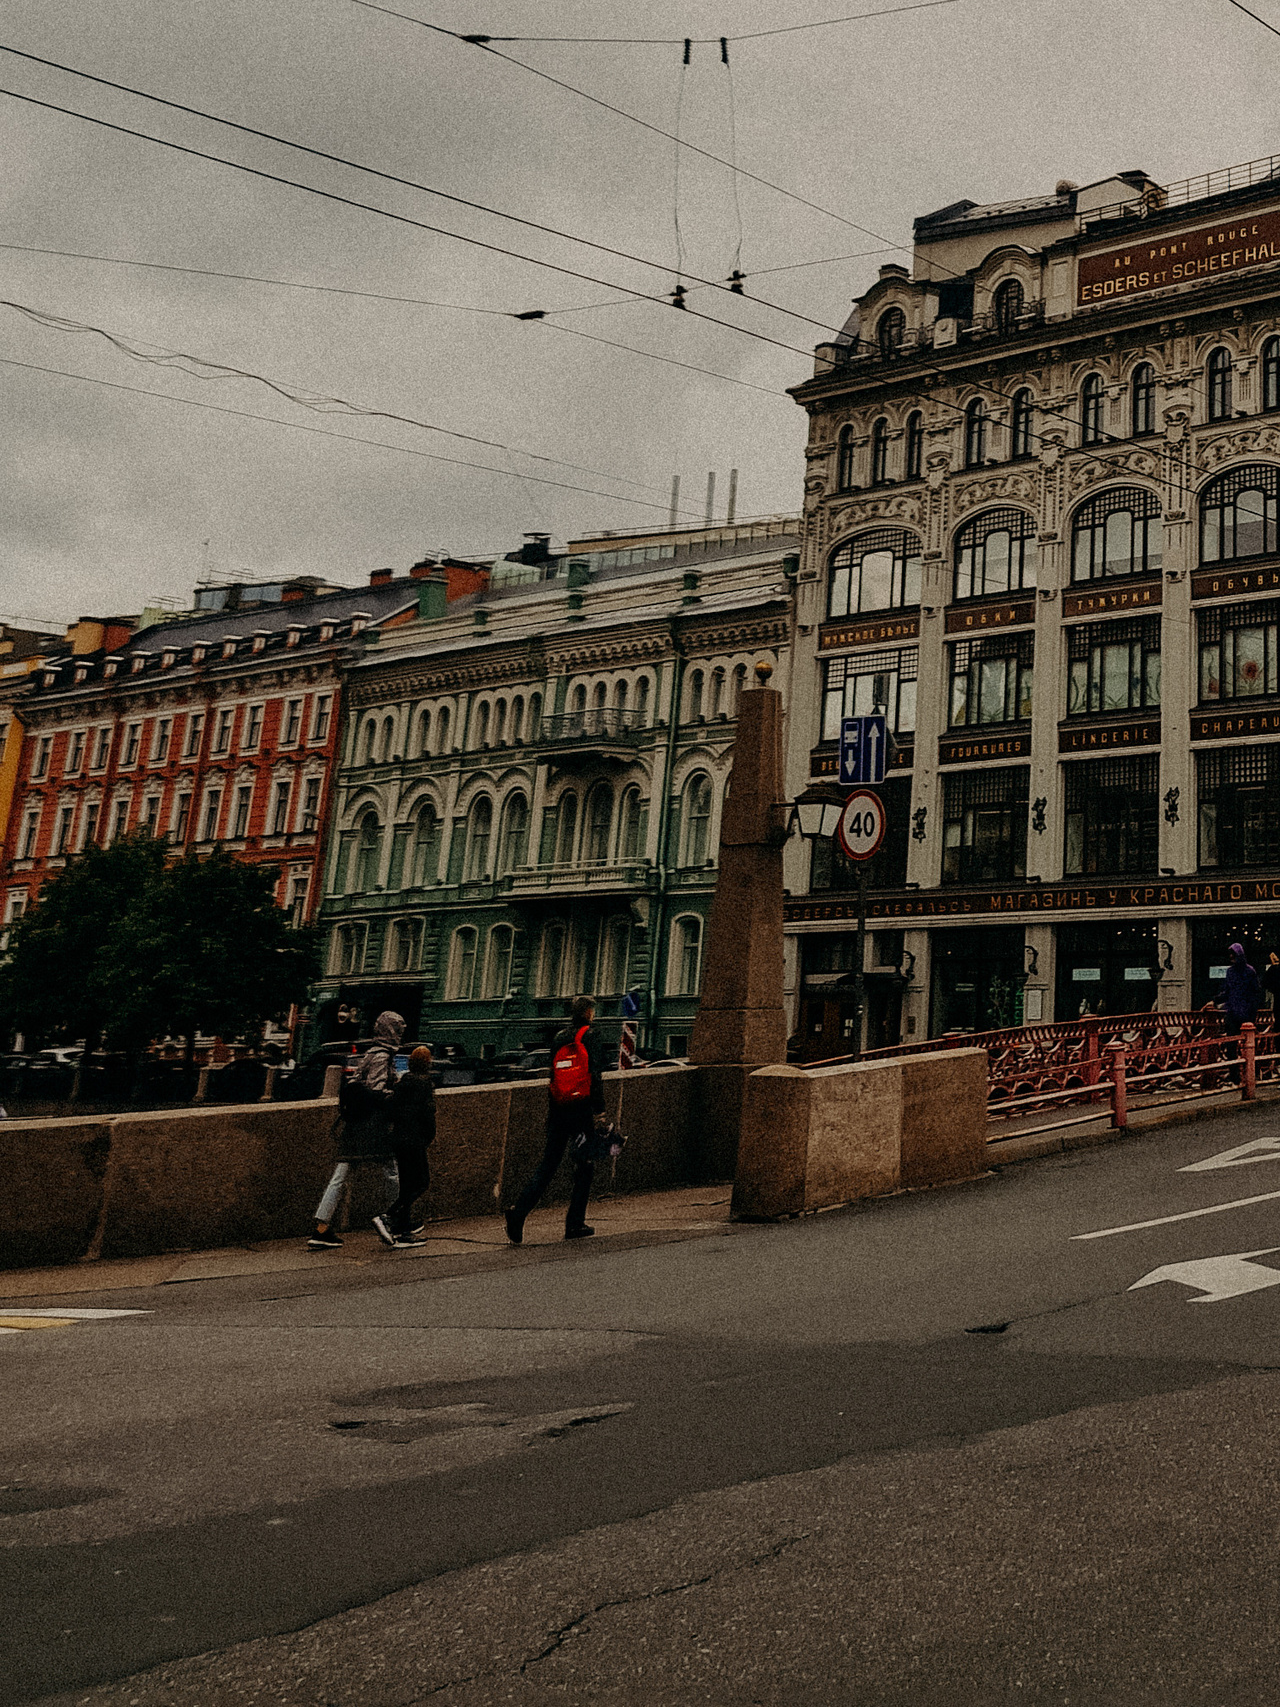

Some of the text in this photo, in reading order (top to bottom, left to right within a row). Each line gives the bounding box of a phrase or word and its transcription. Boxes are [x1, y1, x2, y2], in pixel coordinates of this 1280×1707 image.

[1114, 224, 1259, 268] AU PONT ROUGE
[1081, 271, 1150, 301] ESDERS
[1153, 270, 1168, 284] ET
[1212, 572, 1280, 592] ОБУВЬ
[1077, 590, 1151, 610] ТУЖУРКИ
[849, 811, 875, 838] 40
[990, 890, 1096, 912] МАГАЗИНЪ
[1108, 888, 1118, 906] У
[1129, 883, 1242, 904] КРАСНАГО
